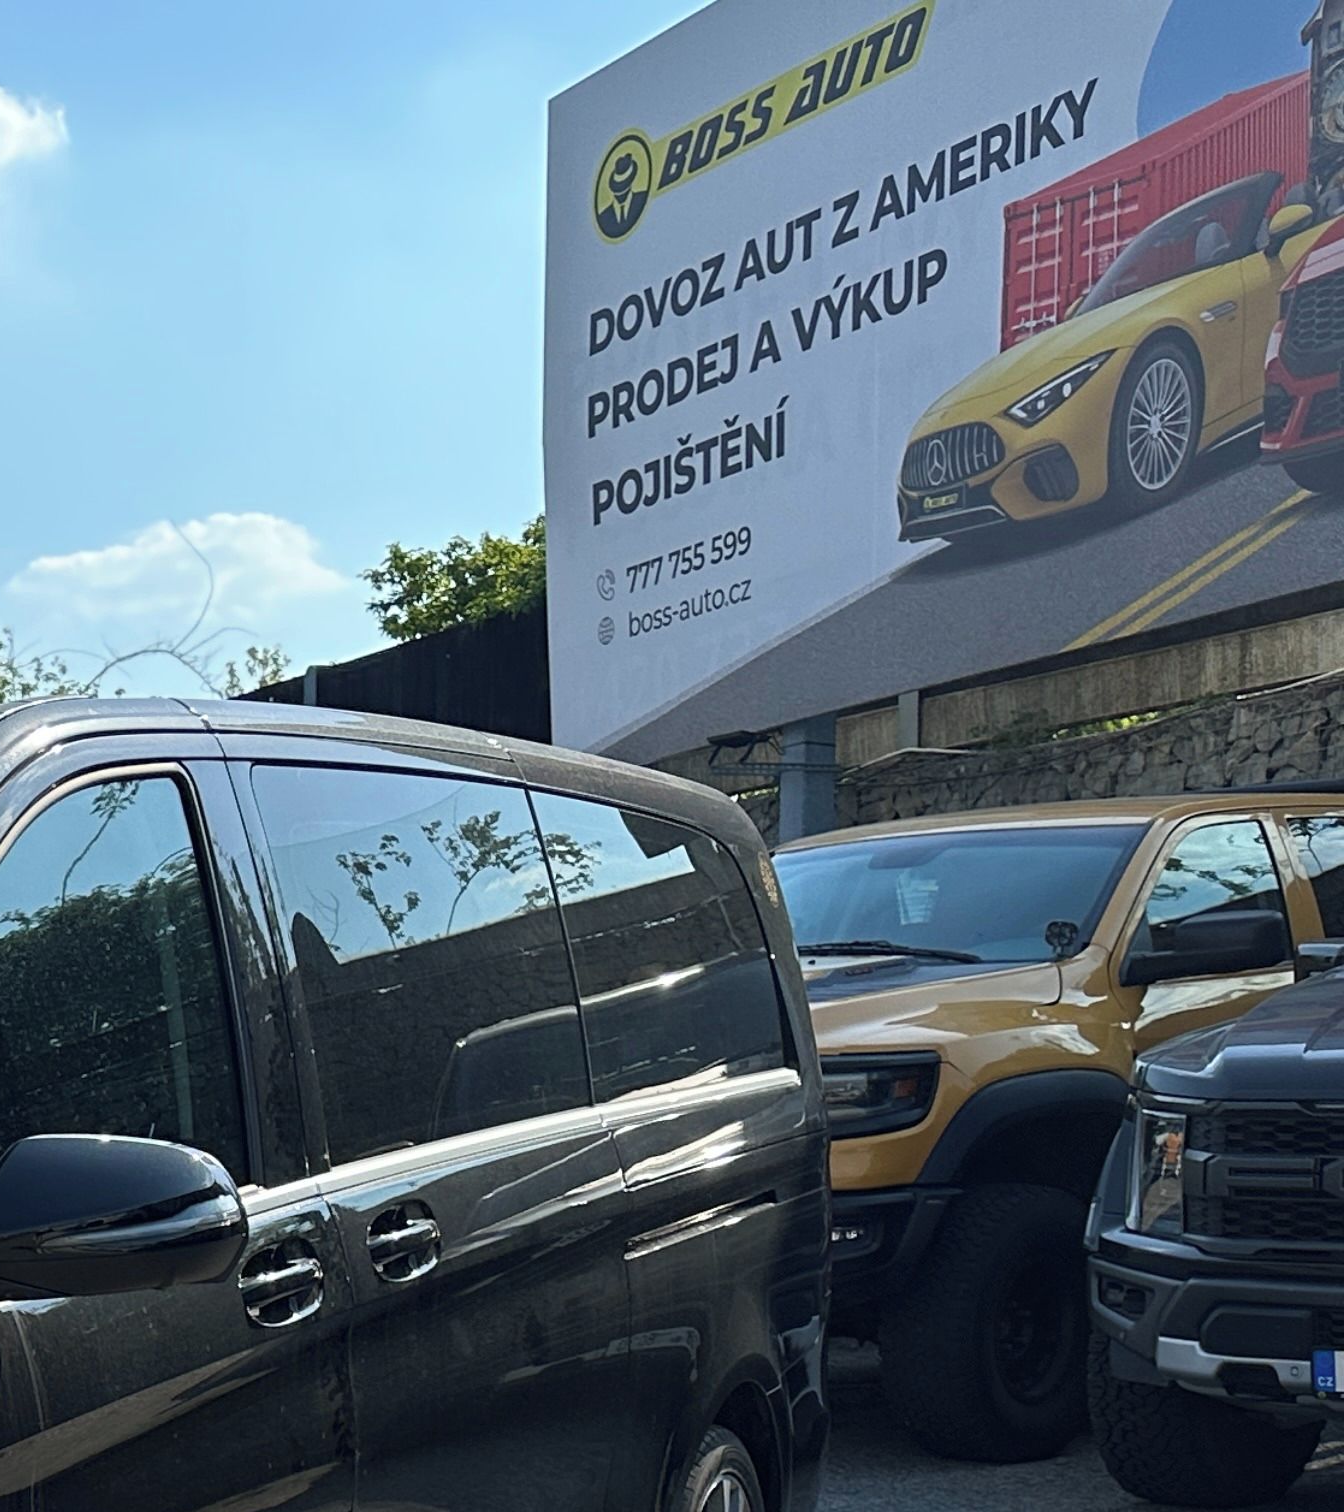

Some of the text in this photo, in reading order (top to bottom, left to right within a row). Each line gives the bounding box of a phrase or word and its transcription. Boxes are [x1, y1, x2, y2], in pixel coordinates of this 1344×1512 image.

[657, 7, 927, 190] BOSS AUTO
[589, 77, 1099, 356] DOVOZ AUT Z AMERIKY
[588, 248, 948, 439] PRODEJ A VÝKUP
[592, 394, 790, 526] POJIŠTĚNÍ
[626, 526, 752, 594] 777 755 599
[628, 579, 752, 638] boss-auto.cz
[1317, 1376, 1334, 1387] CZ
